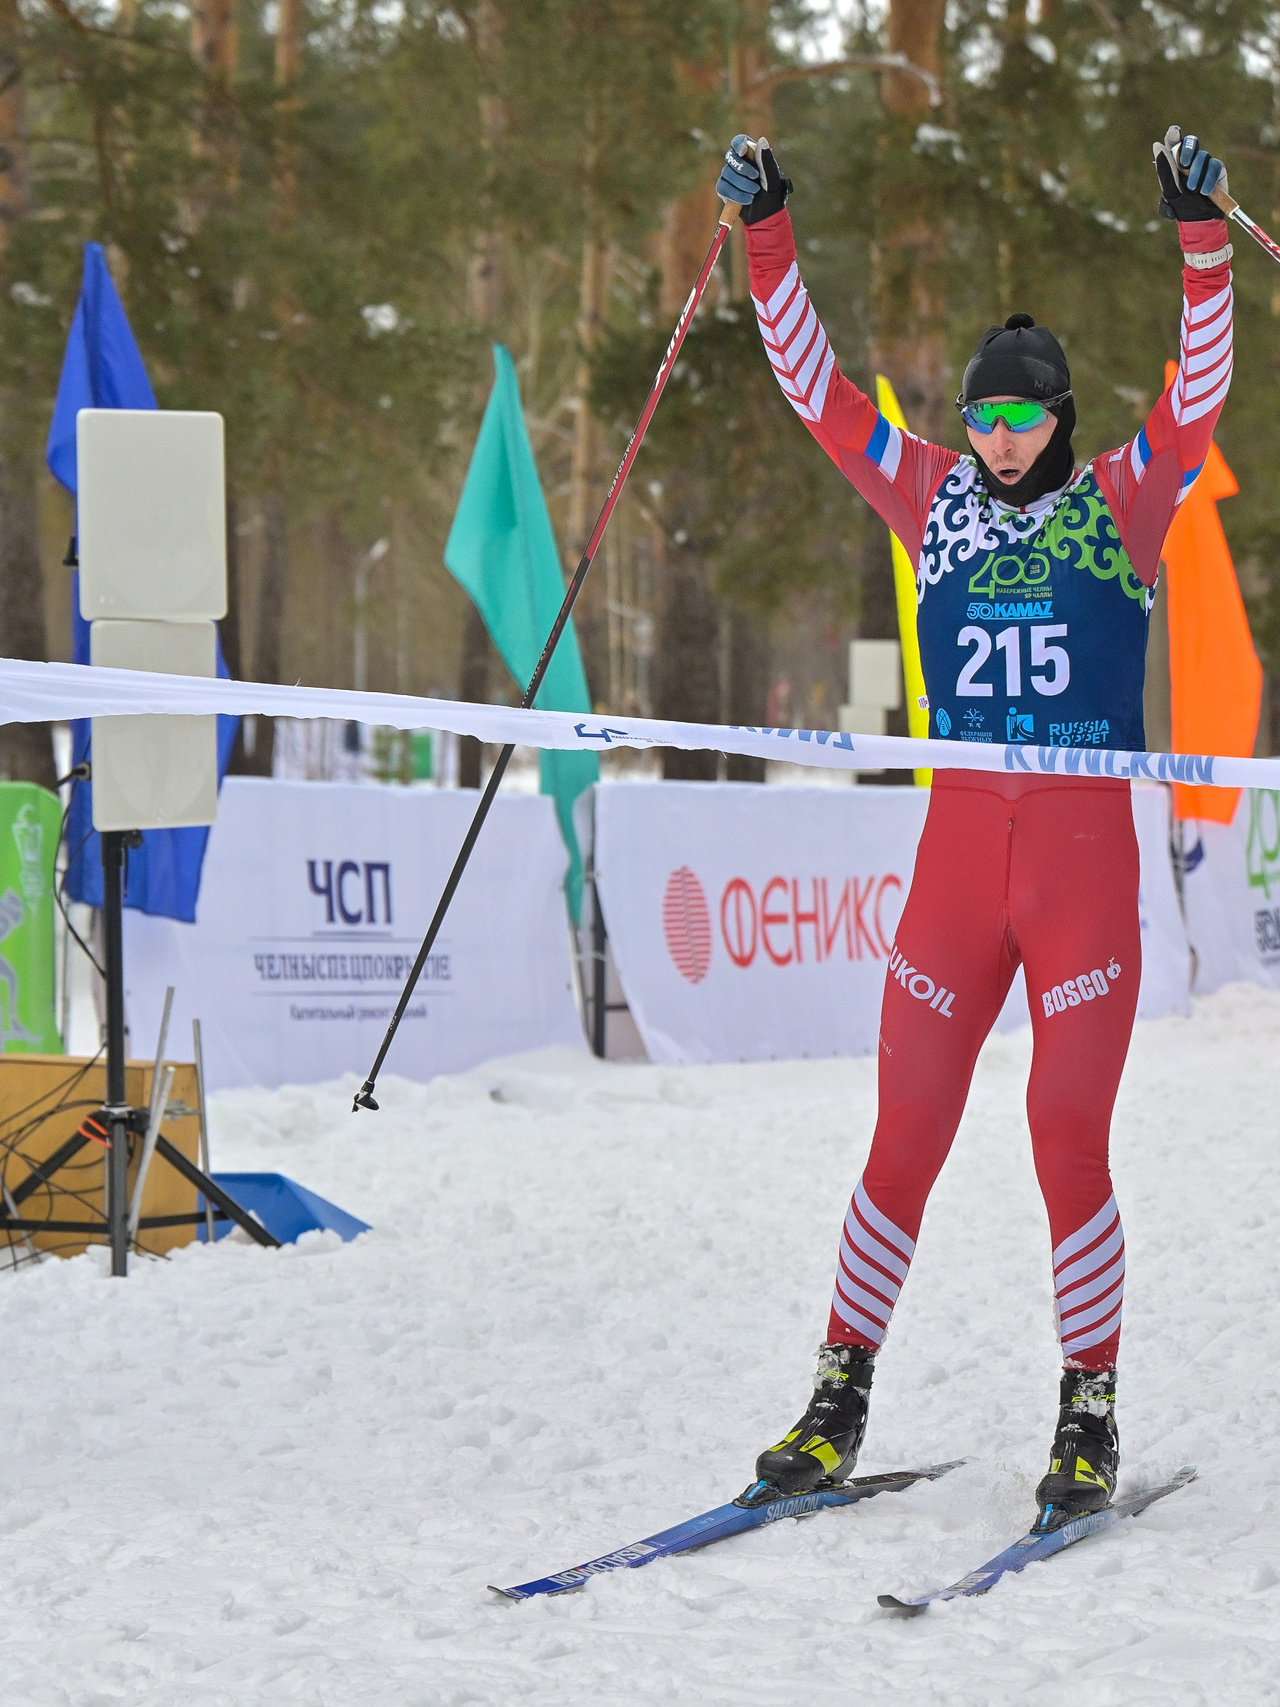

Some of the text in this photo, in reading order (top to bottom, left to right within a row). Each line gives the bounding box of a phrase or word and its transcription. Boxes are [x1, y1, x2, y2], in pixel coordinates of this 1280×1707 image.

[725, 151, 744, 171] Sport
[968, 552, 1050, 599] 400
[955, 623, 1070, 697] 215
[1049, 719, 1110, 736] RUSSIA
[306, 860, 392, 926] ЧСП
[720, 872, 904, 969] ФЕНИКС
[888, 946, 957, 1018] UKOIL
[1042, 969, 1110, 1018] BOSCO
[765, 1496, 819, 1522] SALOMON
